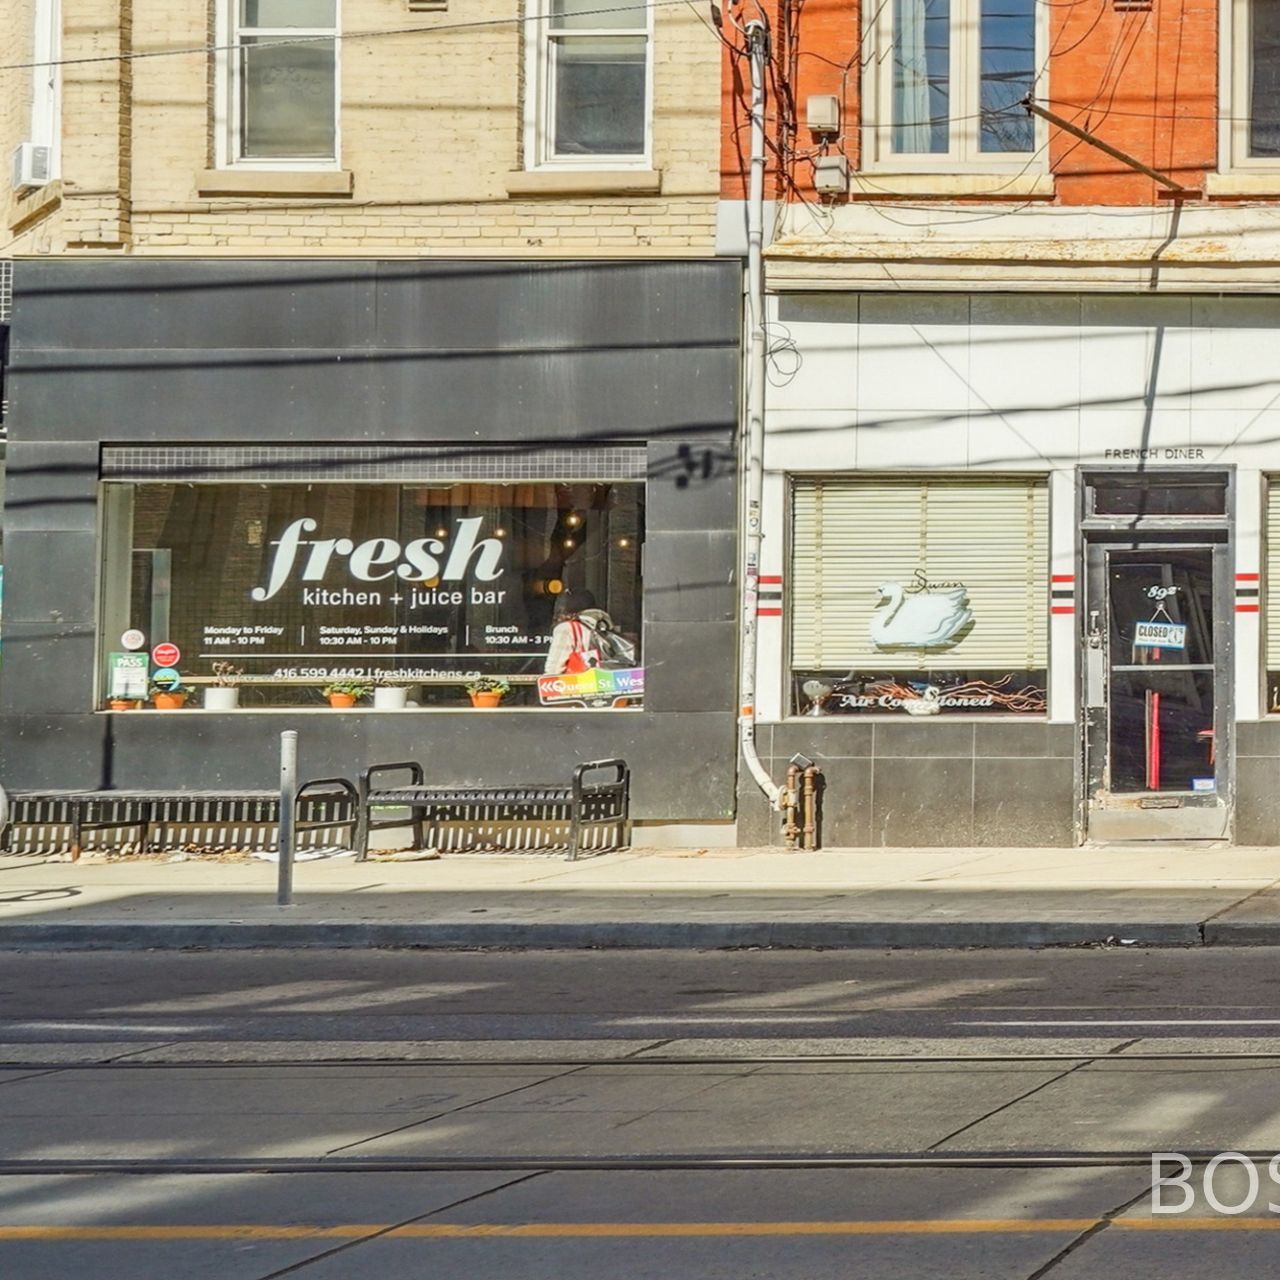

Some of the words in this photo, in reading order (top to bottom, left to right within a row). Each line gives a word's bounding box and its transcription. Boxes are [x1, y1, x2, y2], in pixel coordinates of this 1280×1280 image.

[1105, 449, 1158, 459] FRENCH
[1164, 449, 1204, 459] DINER
[251, 516, 505, 601] fresh
[303, 588, 381, 606] kitchen
[410, 588, 462, 609] juice
[471, 588, 506, 605] bar
[204, 626, 242, 636] Monday
[243, 626, 253, 634] to
[254, 626, 284, 636] Friday
[320, 626, 362, 636] Saturday,
[364, 625, 399, 635] Sunday
[409, 625, 448, 635] Holidays
[485, 625, 518, 633] Brunch
[1138, 625, 1168, 637] CLOSED
[203, 637, 213, 645] 11
[213, 637, 230, 645] AM
[237, 637, 248, 645] 10
[249, 637, 265, 645] PM
[319, 636, 344, 645] 10:30
[345, 636, 362, 645] AM
[369, 636, 380, 645] 10
[381, 636, 397, 645] PM
[485, 635, 510, 644] 10:30
[511, 635, 528, 644] AM
[534, 635, 542, 644] 3
[117, 657, 143, 668] PASS
[373, 668, 481, 680] freshkitchens.ca
[839, 694, 874, 707] Air
